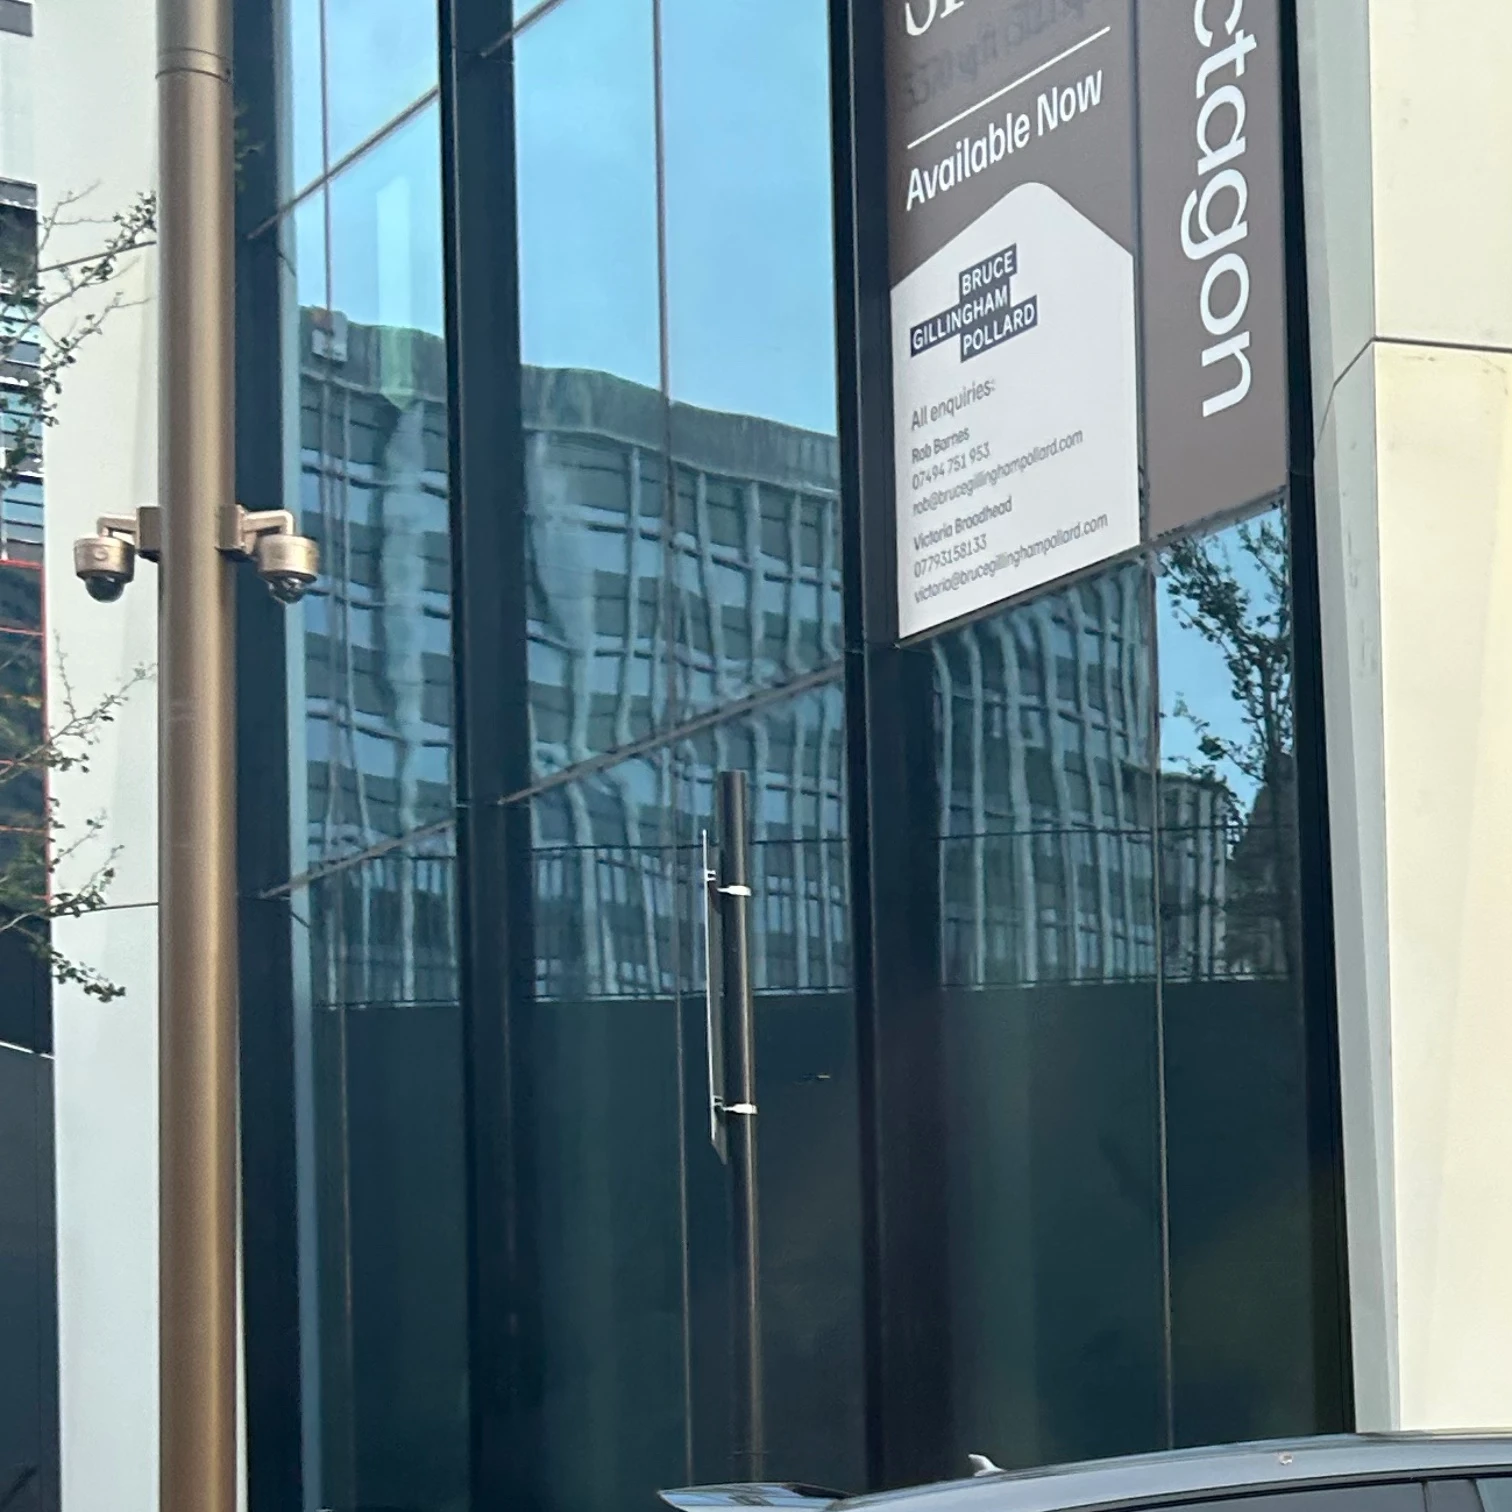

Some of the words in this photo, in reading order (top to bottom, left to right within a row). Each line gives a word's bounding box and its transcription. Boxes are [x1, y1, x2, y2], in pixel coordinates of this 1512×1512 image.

[906, 112, 1031, 211] Available
[1036, 70, 1103, 137] Now
[961, 250, 1014, 296] BRUCE
[912, 284, 1008, 350] GILLINGHAM
[963, 303, 1036, 356] POLLARD
[911, 406, 928, 432] All
